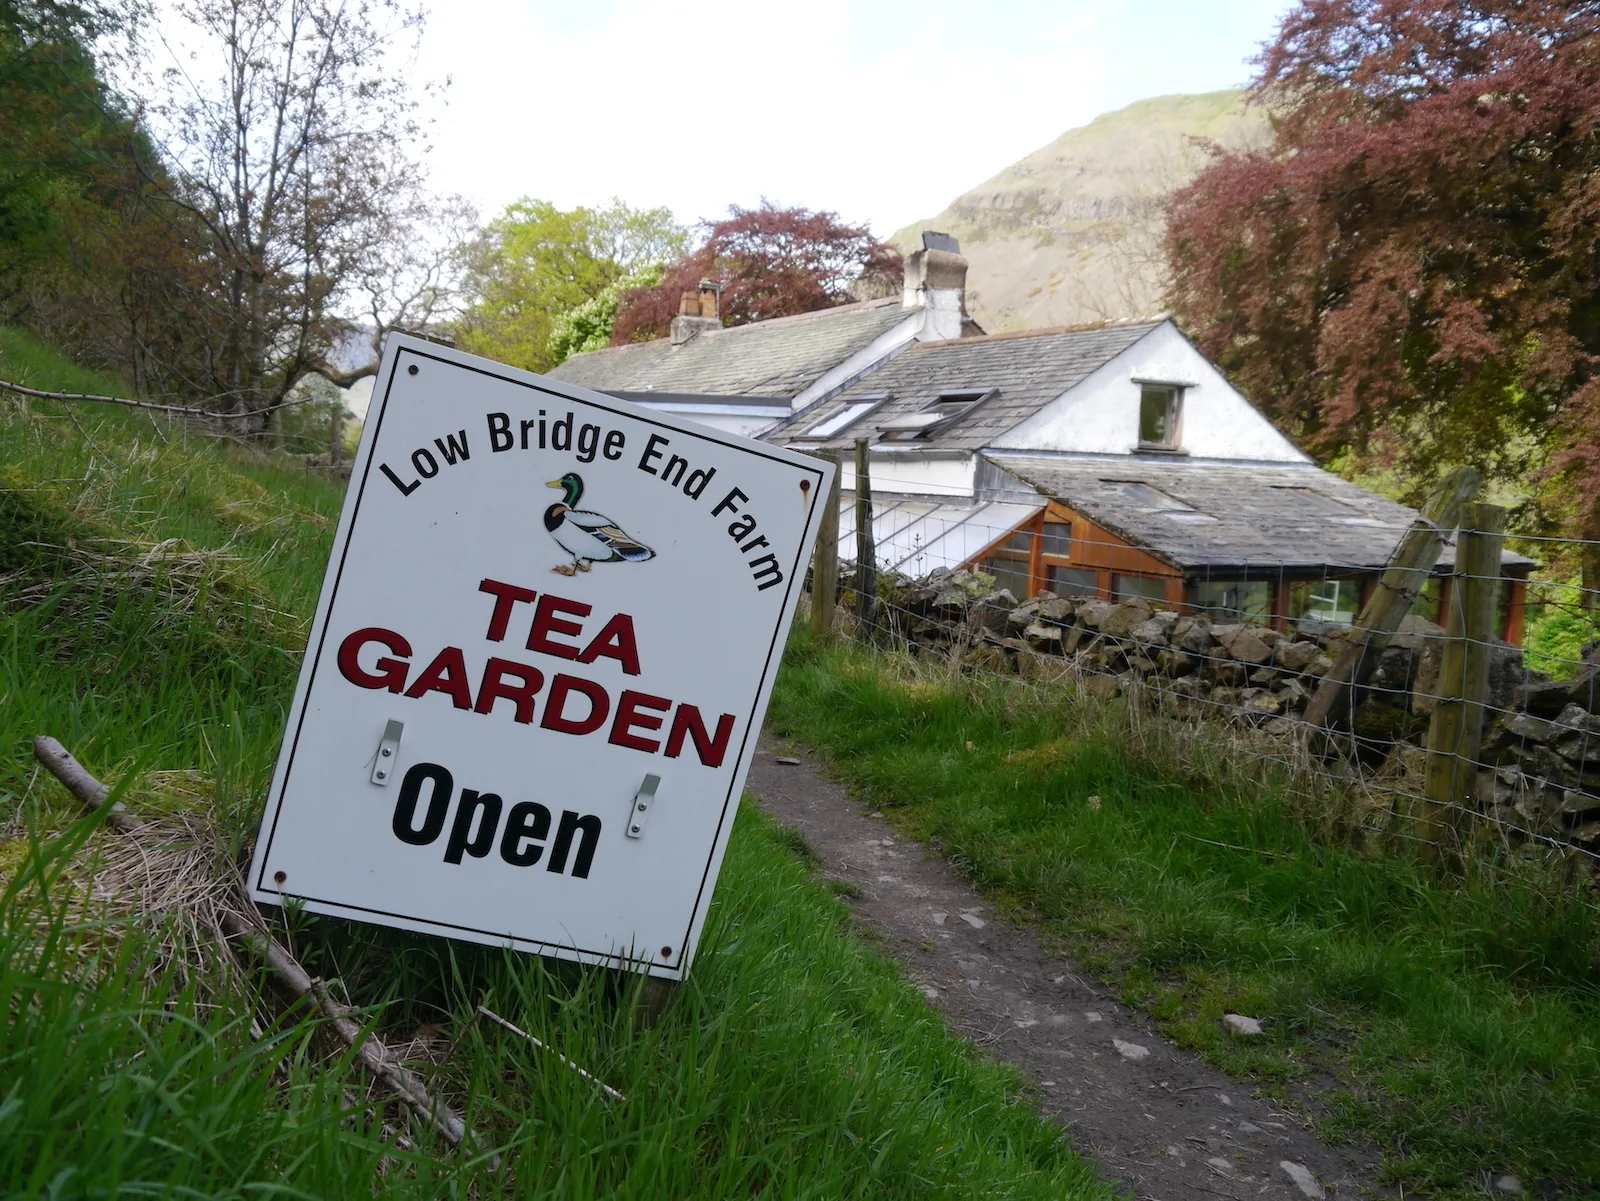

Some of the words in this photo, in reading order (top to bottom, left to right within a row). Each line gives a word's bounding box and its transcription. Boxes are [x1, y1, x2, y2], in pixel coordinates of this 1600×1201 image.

[379, 429, 471, 498] Low
[487, 411, 626, 464] Bridge
[637, 432, 717, 501] End
[711, 486, 784, 592] Farm
[478, 577, 642, 677] TEA
[336, 626, 737, 769] GARDEN
[391, 762, 602, 880] Open
